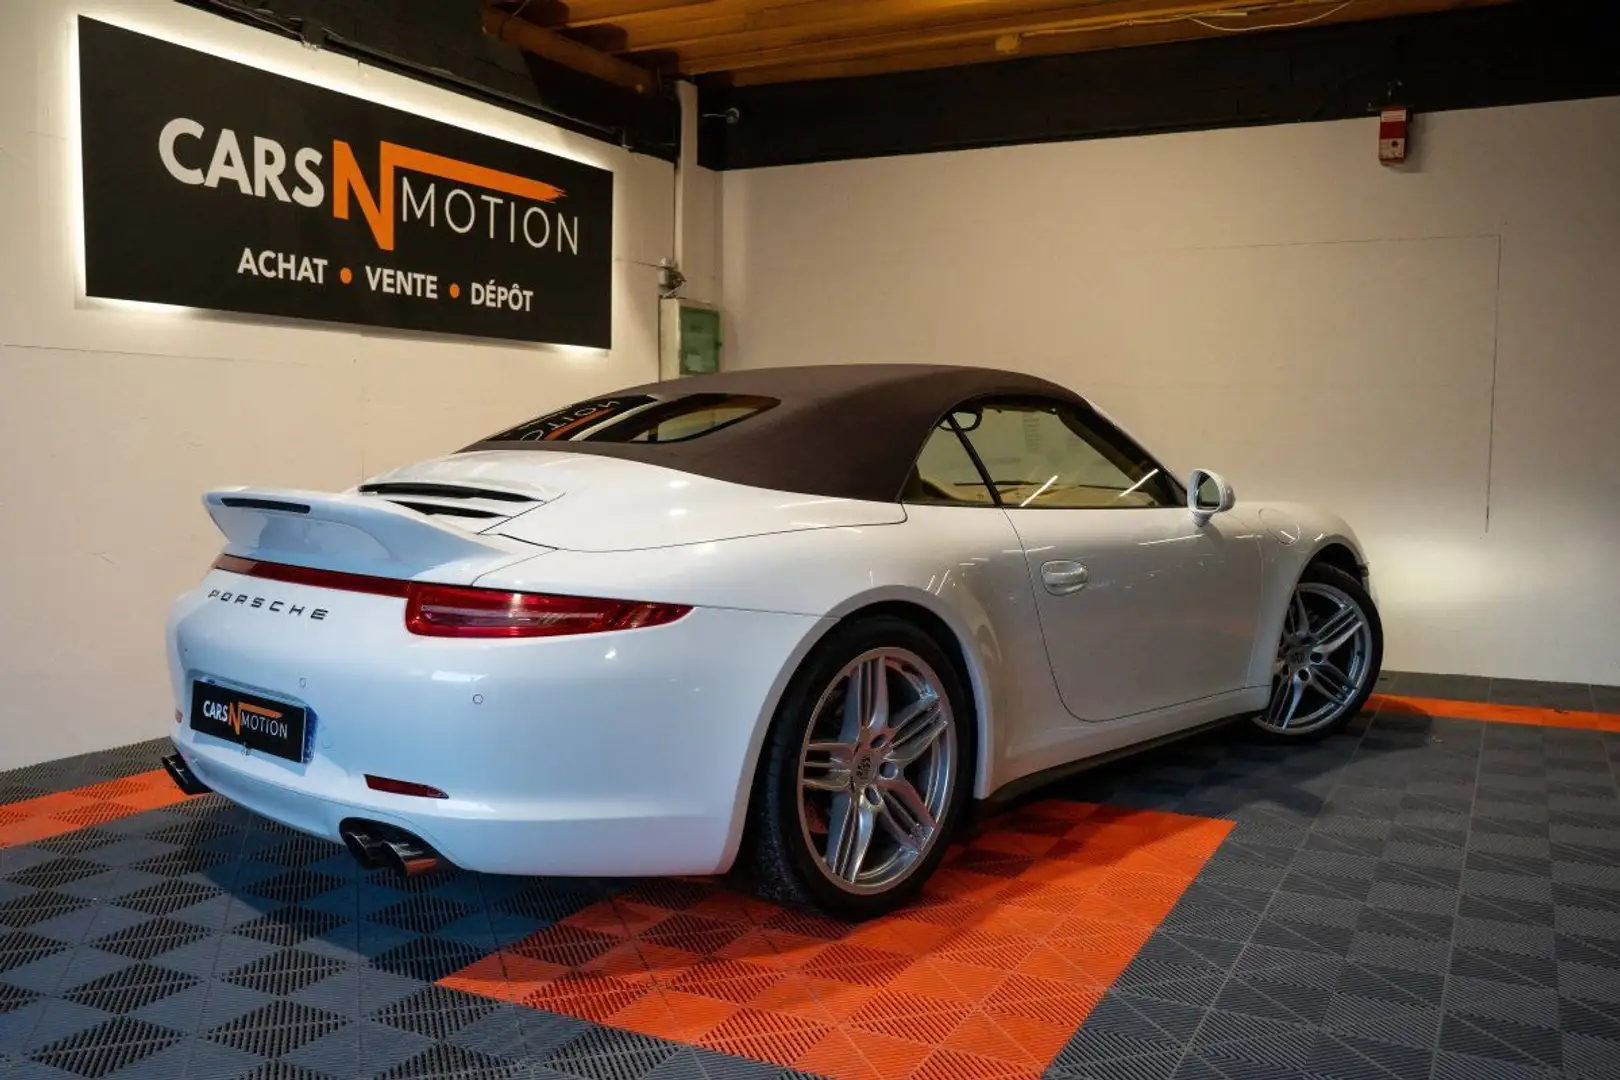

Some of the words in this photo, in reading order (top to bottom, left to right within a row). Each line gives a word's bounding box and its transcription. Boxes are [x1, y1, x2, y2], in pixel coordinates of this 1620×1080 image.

[158, 117, 325, 208] CARS
[402, 176, 579, 256] MOTION
[237, 247, 328, 285] ACHAT
[365, 265, 438, 300] VENTE
[470, 279, 534, 313] DÉPÔT
[207, 588, 329, 620] PORSCHE
[203, 700, 228, 723] CARS
[241, 712, 288, 740] MOTION
